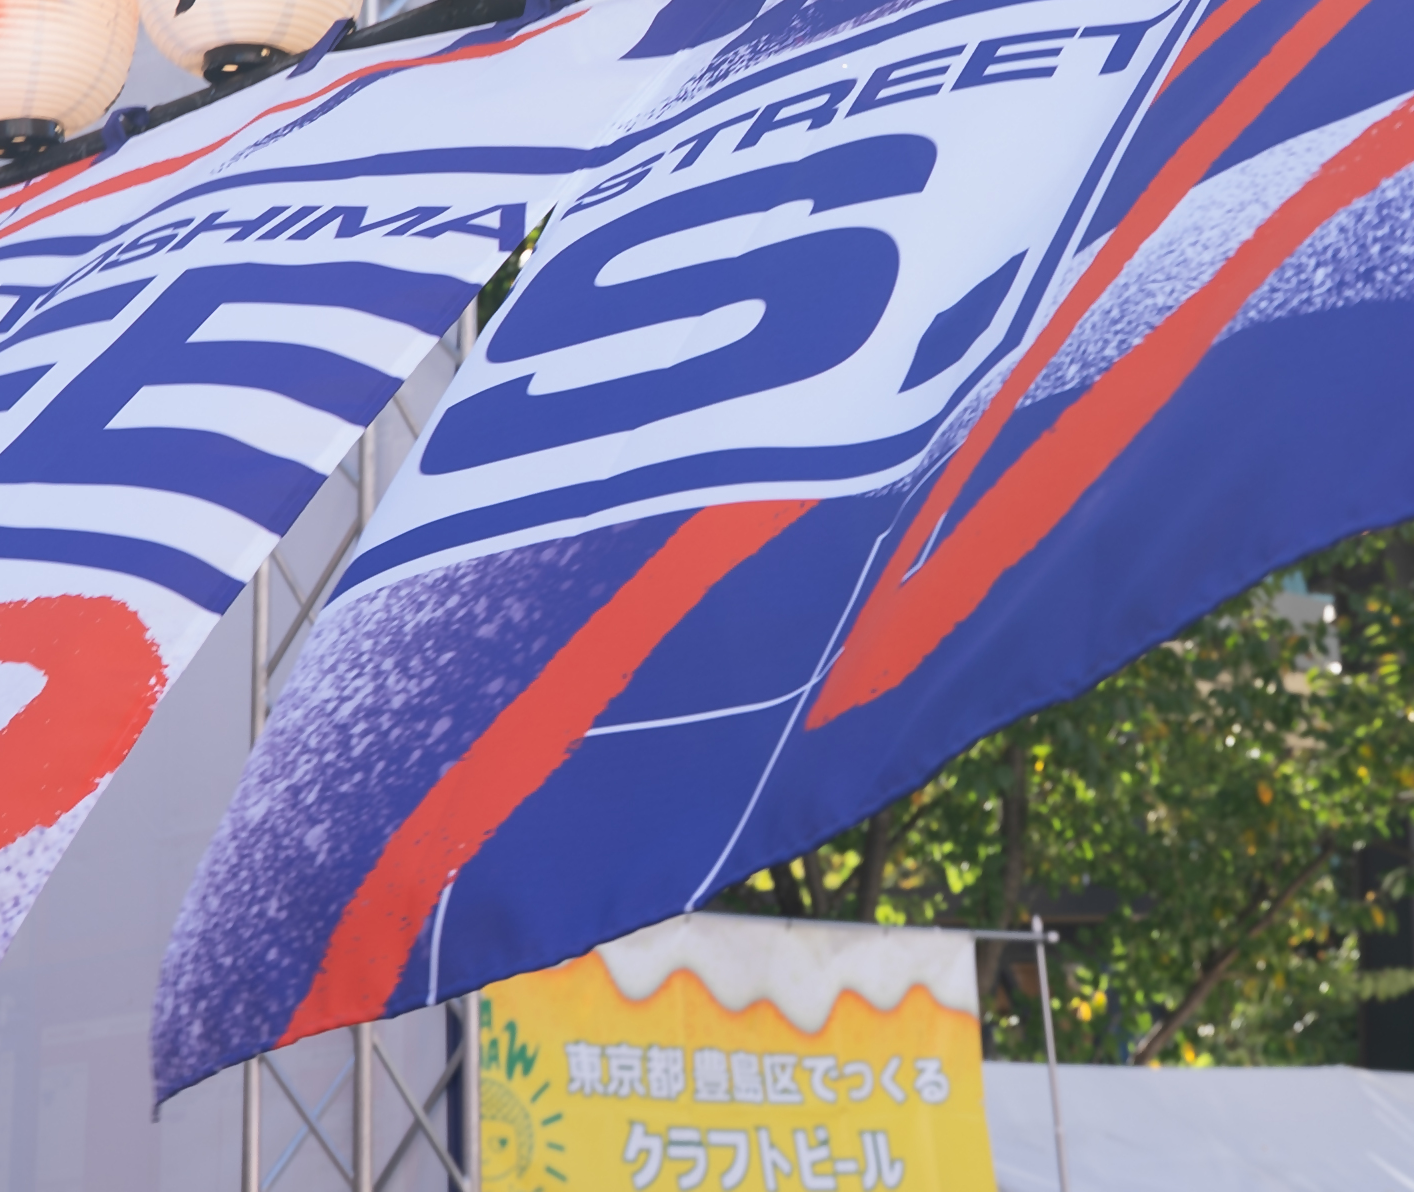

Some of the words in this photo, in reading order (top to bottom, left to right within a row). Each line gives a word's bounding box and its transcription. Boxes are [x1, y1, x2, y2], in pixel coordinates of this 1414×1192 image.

[561, 19, 1162, 221] STREET
[623, 1120, 905, 1192] クラフトビール
